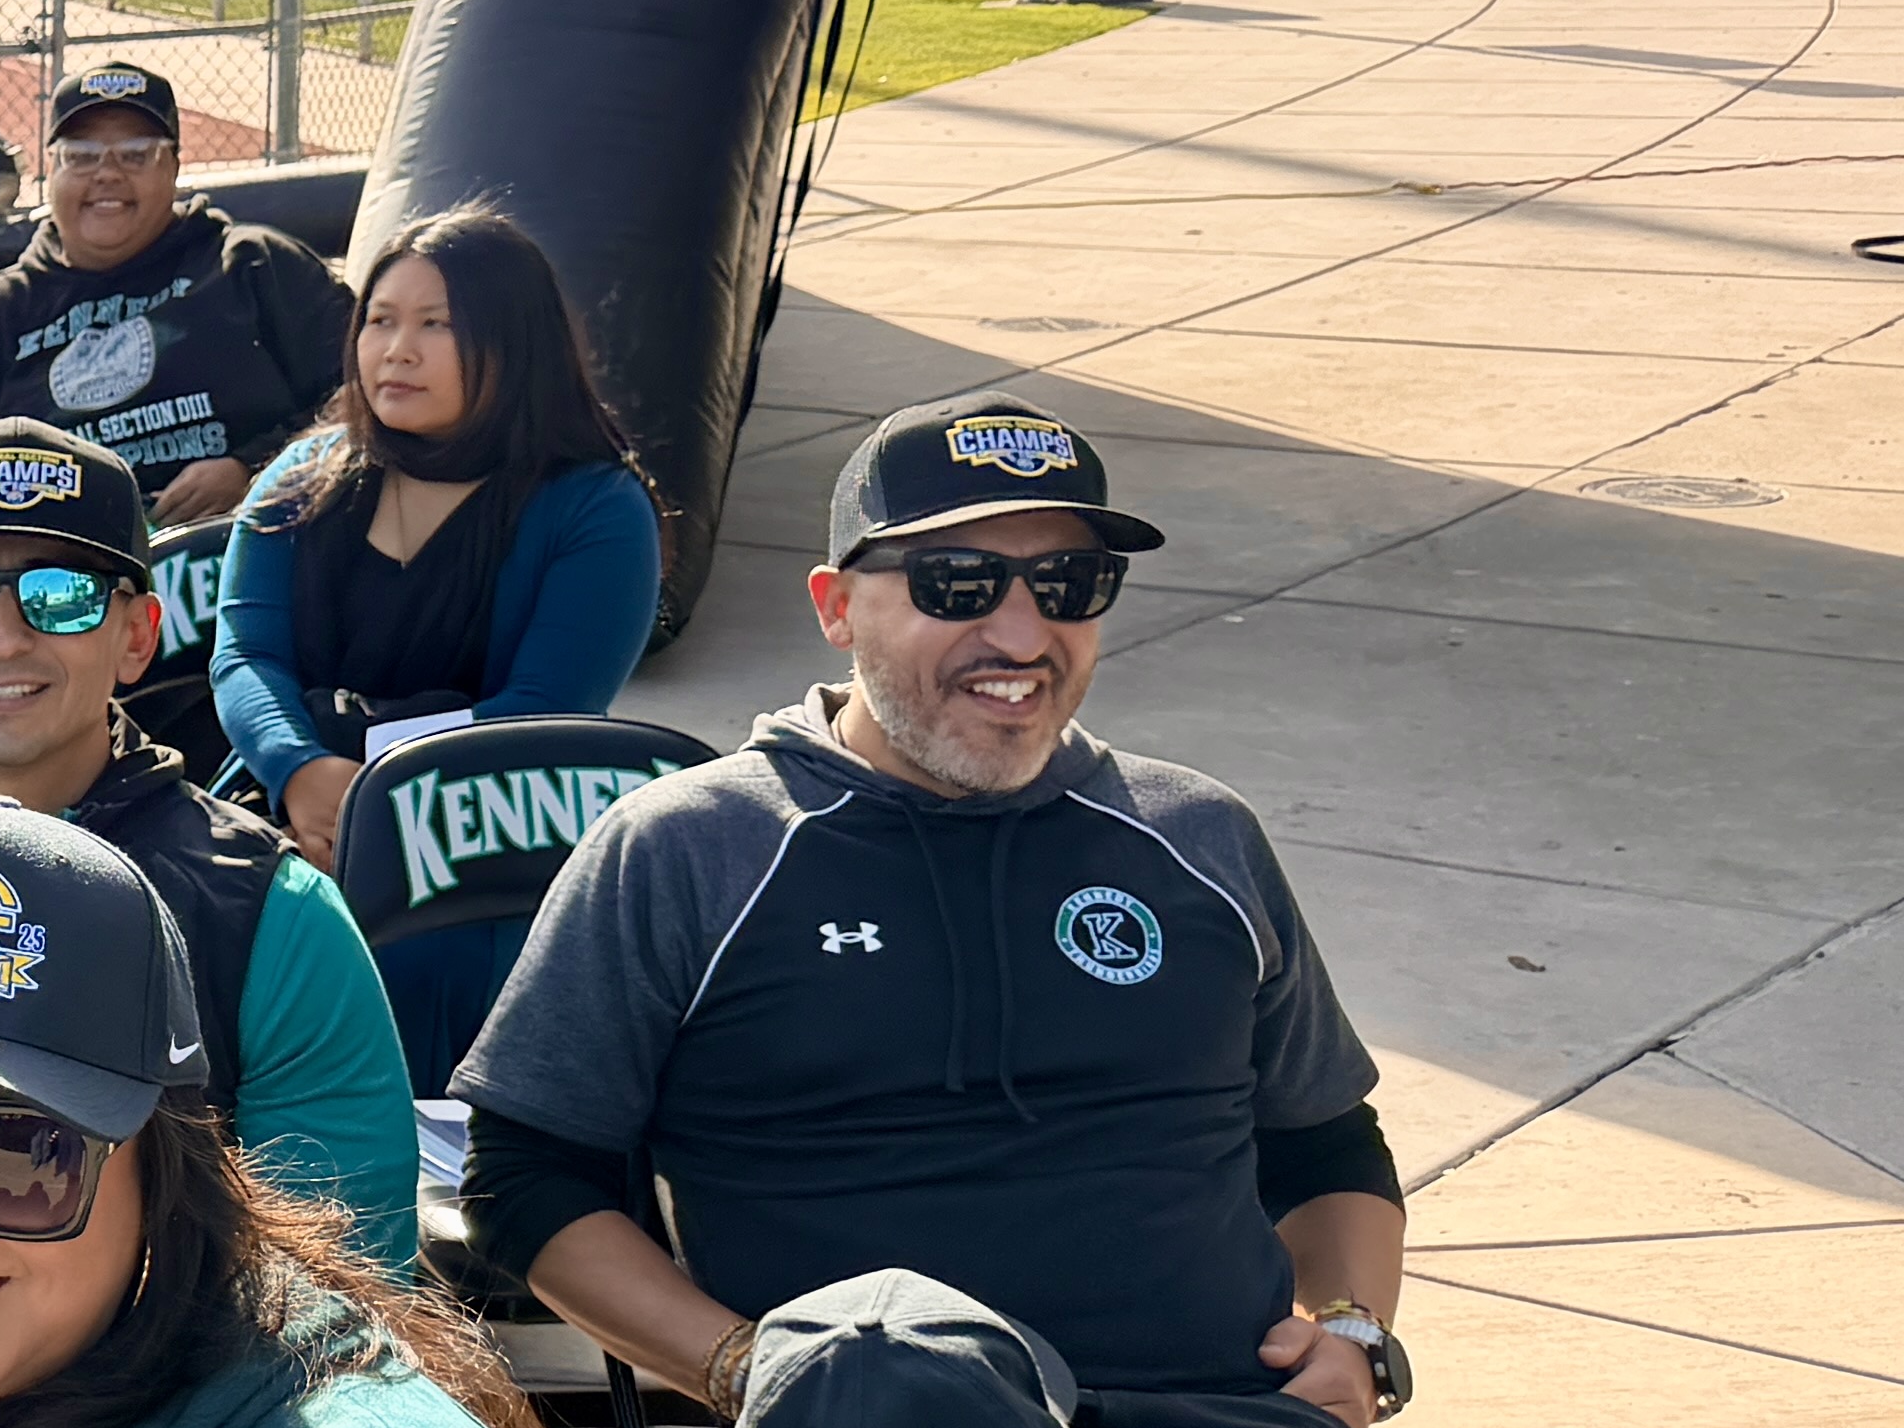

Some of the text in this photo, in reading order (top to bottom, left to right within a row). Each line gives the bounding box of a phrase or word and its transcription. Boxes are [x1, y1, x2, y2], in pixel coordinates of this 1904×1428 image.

[99, 398, 177, 443] SECTION
[174, 391, 214, 423] DIII
[114, 422, 228, 466] PIONS
[957, 428, 1069, 457] CHAMPS
[389, 756, 682, 909] KENNE
[16, 923, 46, 953] 25
[1082, 913, 1139, 960] K
